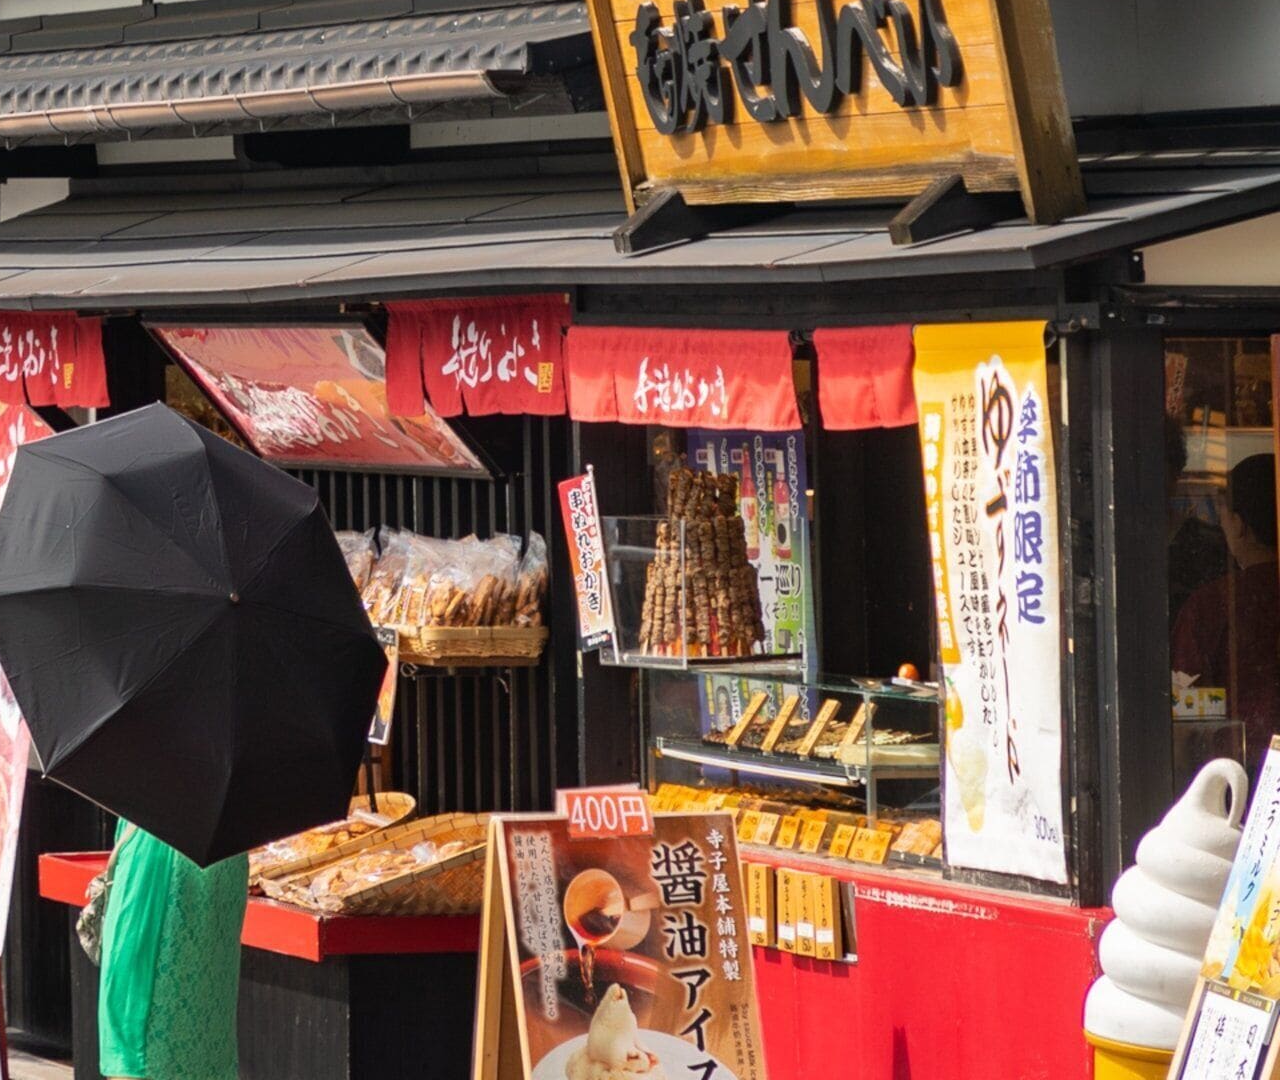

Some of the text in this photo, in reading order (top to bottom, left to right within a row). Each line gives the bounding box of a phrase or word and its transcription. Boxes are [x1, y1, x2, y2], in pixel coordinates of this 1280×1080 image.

[569, 490, 601, 610] 串ぬれおかき
[1014, 388, 1046, 626] 季節限定
[570, 794, 648, 832] 400円
[705, 828, 742, 982] 寺子屋本舗特製
